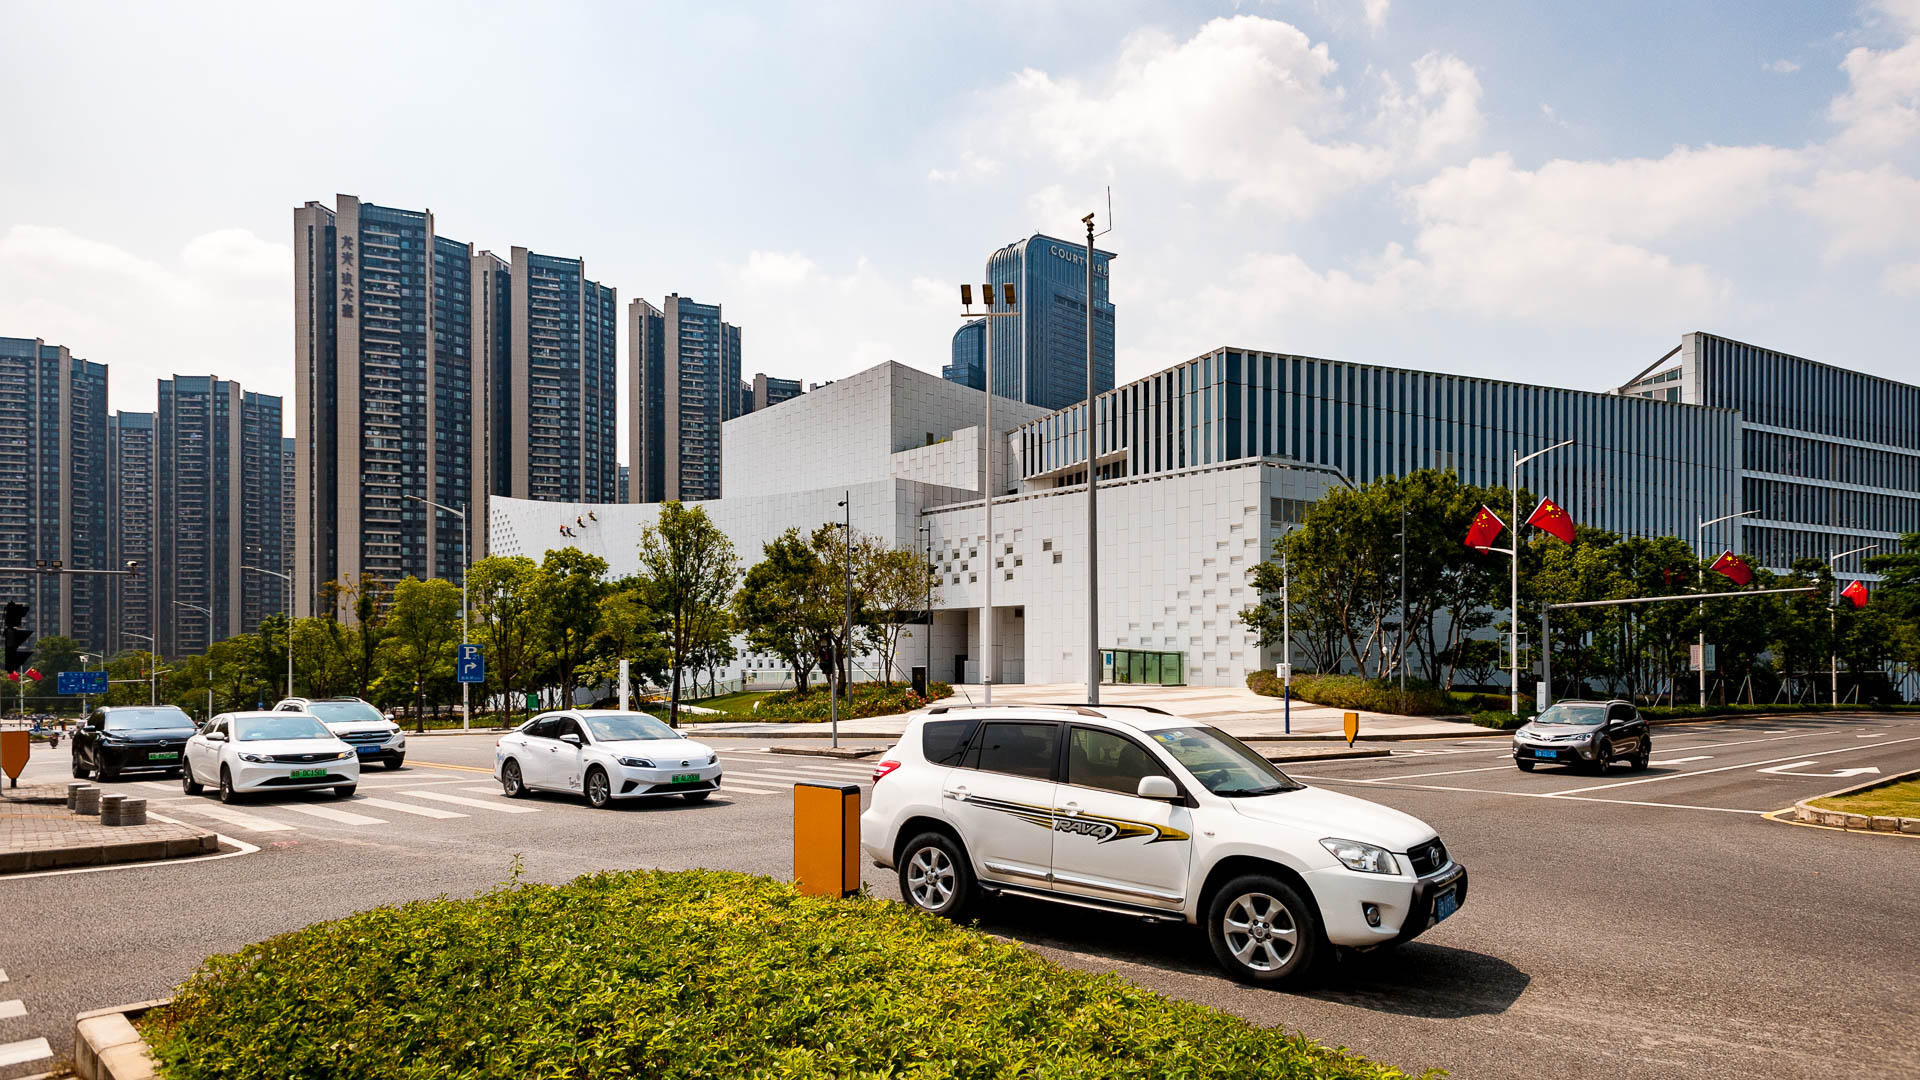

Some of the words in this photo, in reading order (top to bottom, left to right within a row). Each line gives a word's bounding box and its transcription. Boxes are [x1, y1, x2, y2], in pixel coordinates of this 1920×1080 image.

[1050, 245, 1109, 276] COURTRD
[463, 646, 478, 660] P
[1055, 820, 1107, 838] RAV4
